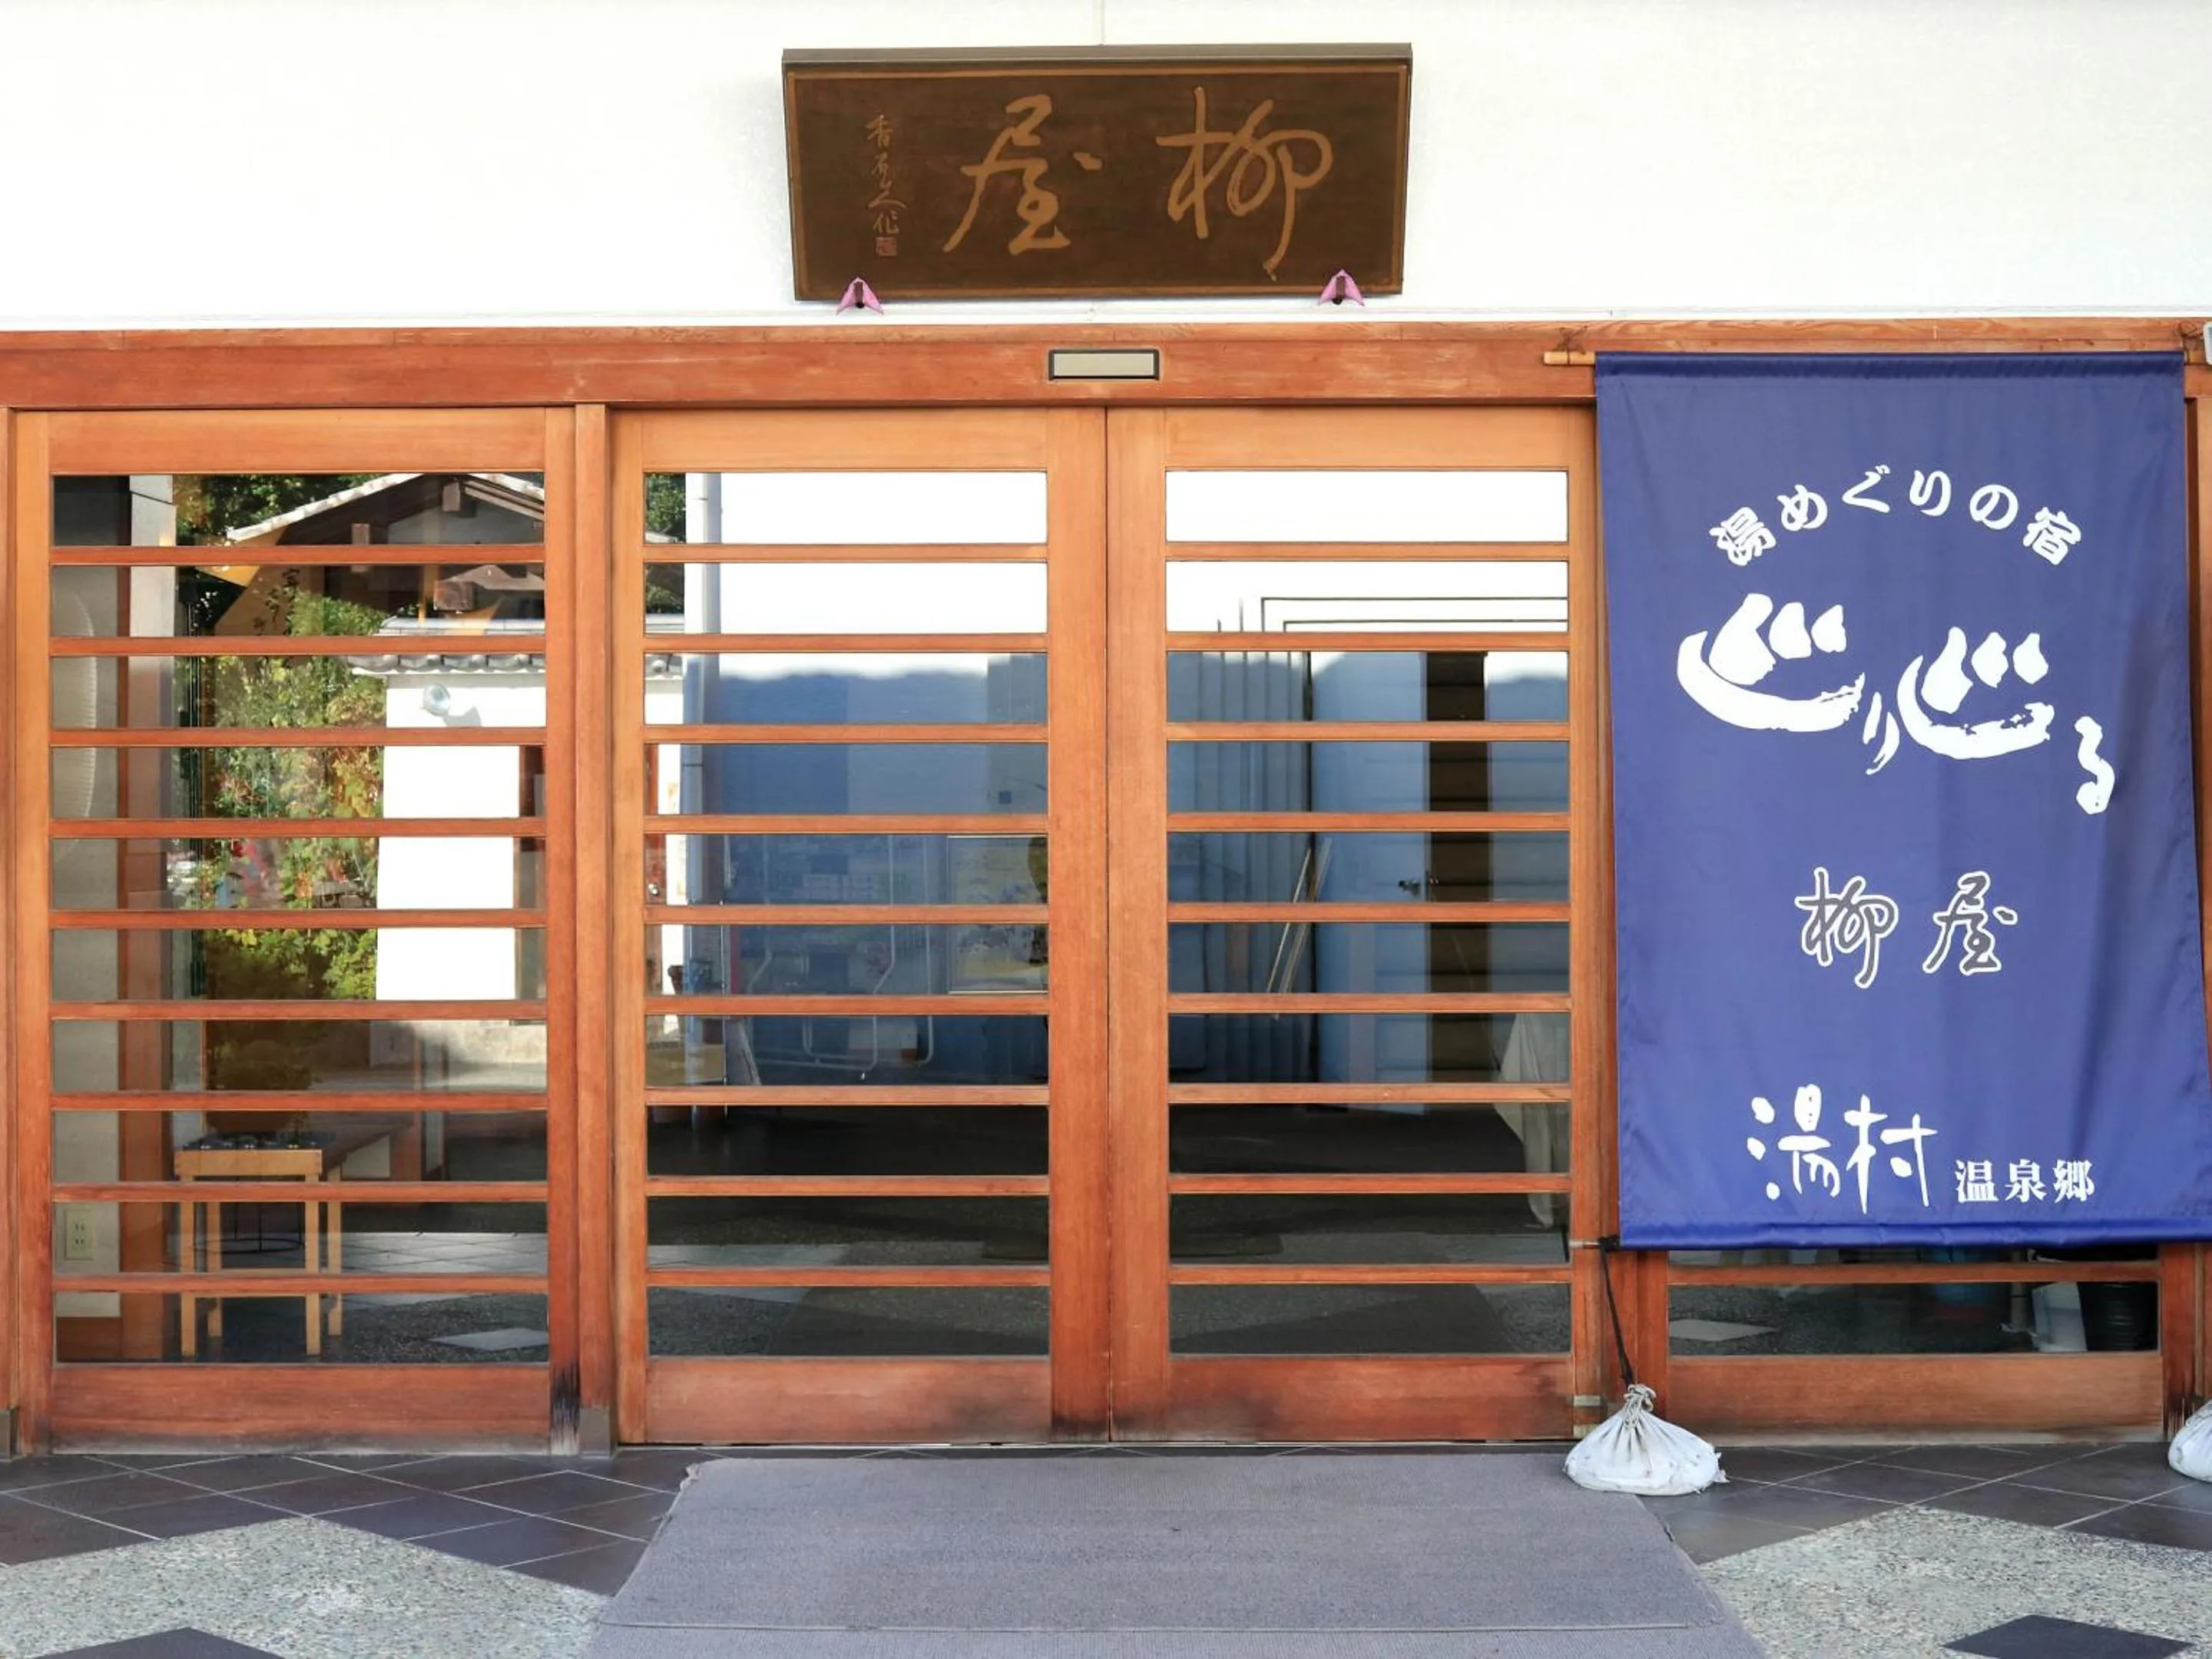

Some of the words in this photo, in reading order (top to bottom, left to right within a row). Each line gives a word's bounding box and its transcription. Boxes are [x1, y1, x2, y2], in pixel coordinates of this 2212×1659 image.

[1710, 464, 2081, 566] 湯めぐりの宿
[1794, 866, 2018, 989] 柳屋
[1747, 1083, 1938, 1214] 湯村
[1955, 1158, 2094, 1204] 温泉郷
